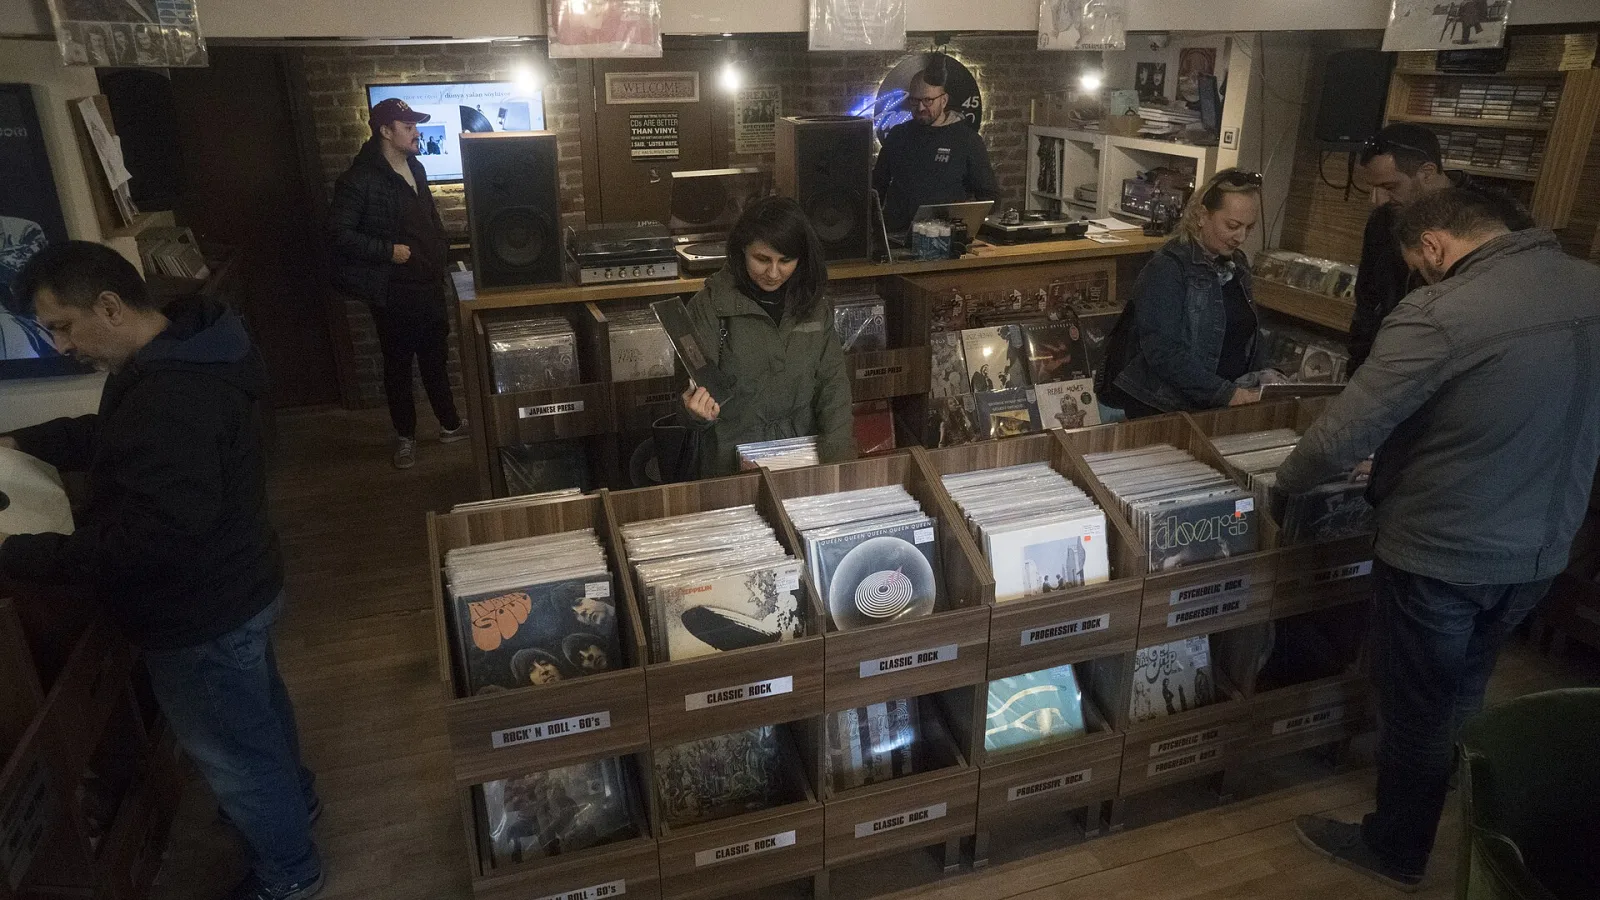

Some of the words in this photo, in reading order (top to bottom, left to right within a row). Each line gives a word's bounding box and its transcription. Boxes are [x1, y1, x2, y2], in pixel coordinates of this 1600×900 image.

[623, 82, 679, 94] WELCOME
[961, 96, 980, 108] 45
[630, 119, 642, 127] CDs
[644, 119, 656, 127] ARE
[656, 118, 678, 126] BETTER
[864, 368, 886, 376] JAPANESE
[888, 366, 902, 374] PRESS
[529, 405, 556, 416] JAPANESE
[557, 404, 574, 413] PRESS
[821, 537, 842, 546] QUEEN
[844, 533, 865, 542] QUEEN
[867, 529, 888, 538] QUEEN
[889, 525, 910, 533] QUEEN
[911, 521, 932, 530] QUEEN
[1178, 583, 1220, 602] PSYCHEDELIC
[1224, 579, 1242, 592] ROCK
[1175, 605, 1218, 623] PROGRESSIVE
[1222, 600, 1240, 612] ROCK
[1030, 622, 1078, 642] PROGRESSIVE
[1081, 618, 1101, 631] ROCK
[879, 656, 913, 672] CLASSIC
[917, 651, 939, 664] ROCK
[706, 688, 744, 704] CLASSIC
[748, 682, 772, 696] ROCK
[535, 726, 542, 737] N
[548, 723, 570, 736] ROLL
[579, 716, 600, 730] 60's
[1158, 735, 1198, 753] PSYCHEDELIC
[1201, 730, 1218, 742] ROCK
[1155, 754, 1196, 773] PROGRESSIVE
[1199, 750, 1216, 761] ROCK
[1016, 779, 1061, 797] PROGRESSIVE
[1065, 774, 1084, 785] ROCK
[873, 816, 904, 832] CLASSIC
[908, 810, 929, 823] ROCK
[715, 844, 750, 860] CLASSIC
[754, 838, 776, 851] ROCK
[567, 890, 588, 900] ROLL
[596, 885, 616, 898] 60's
